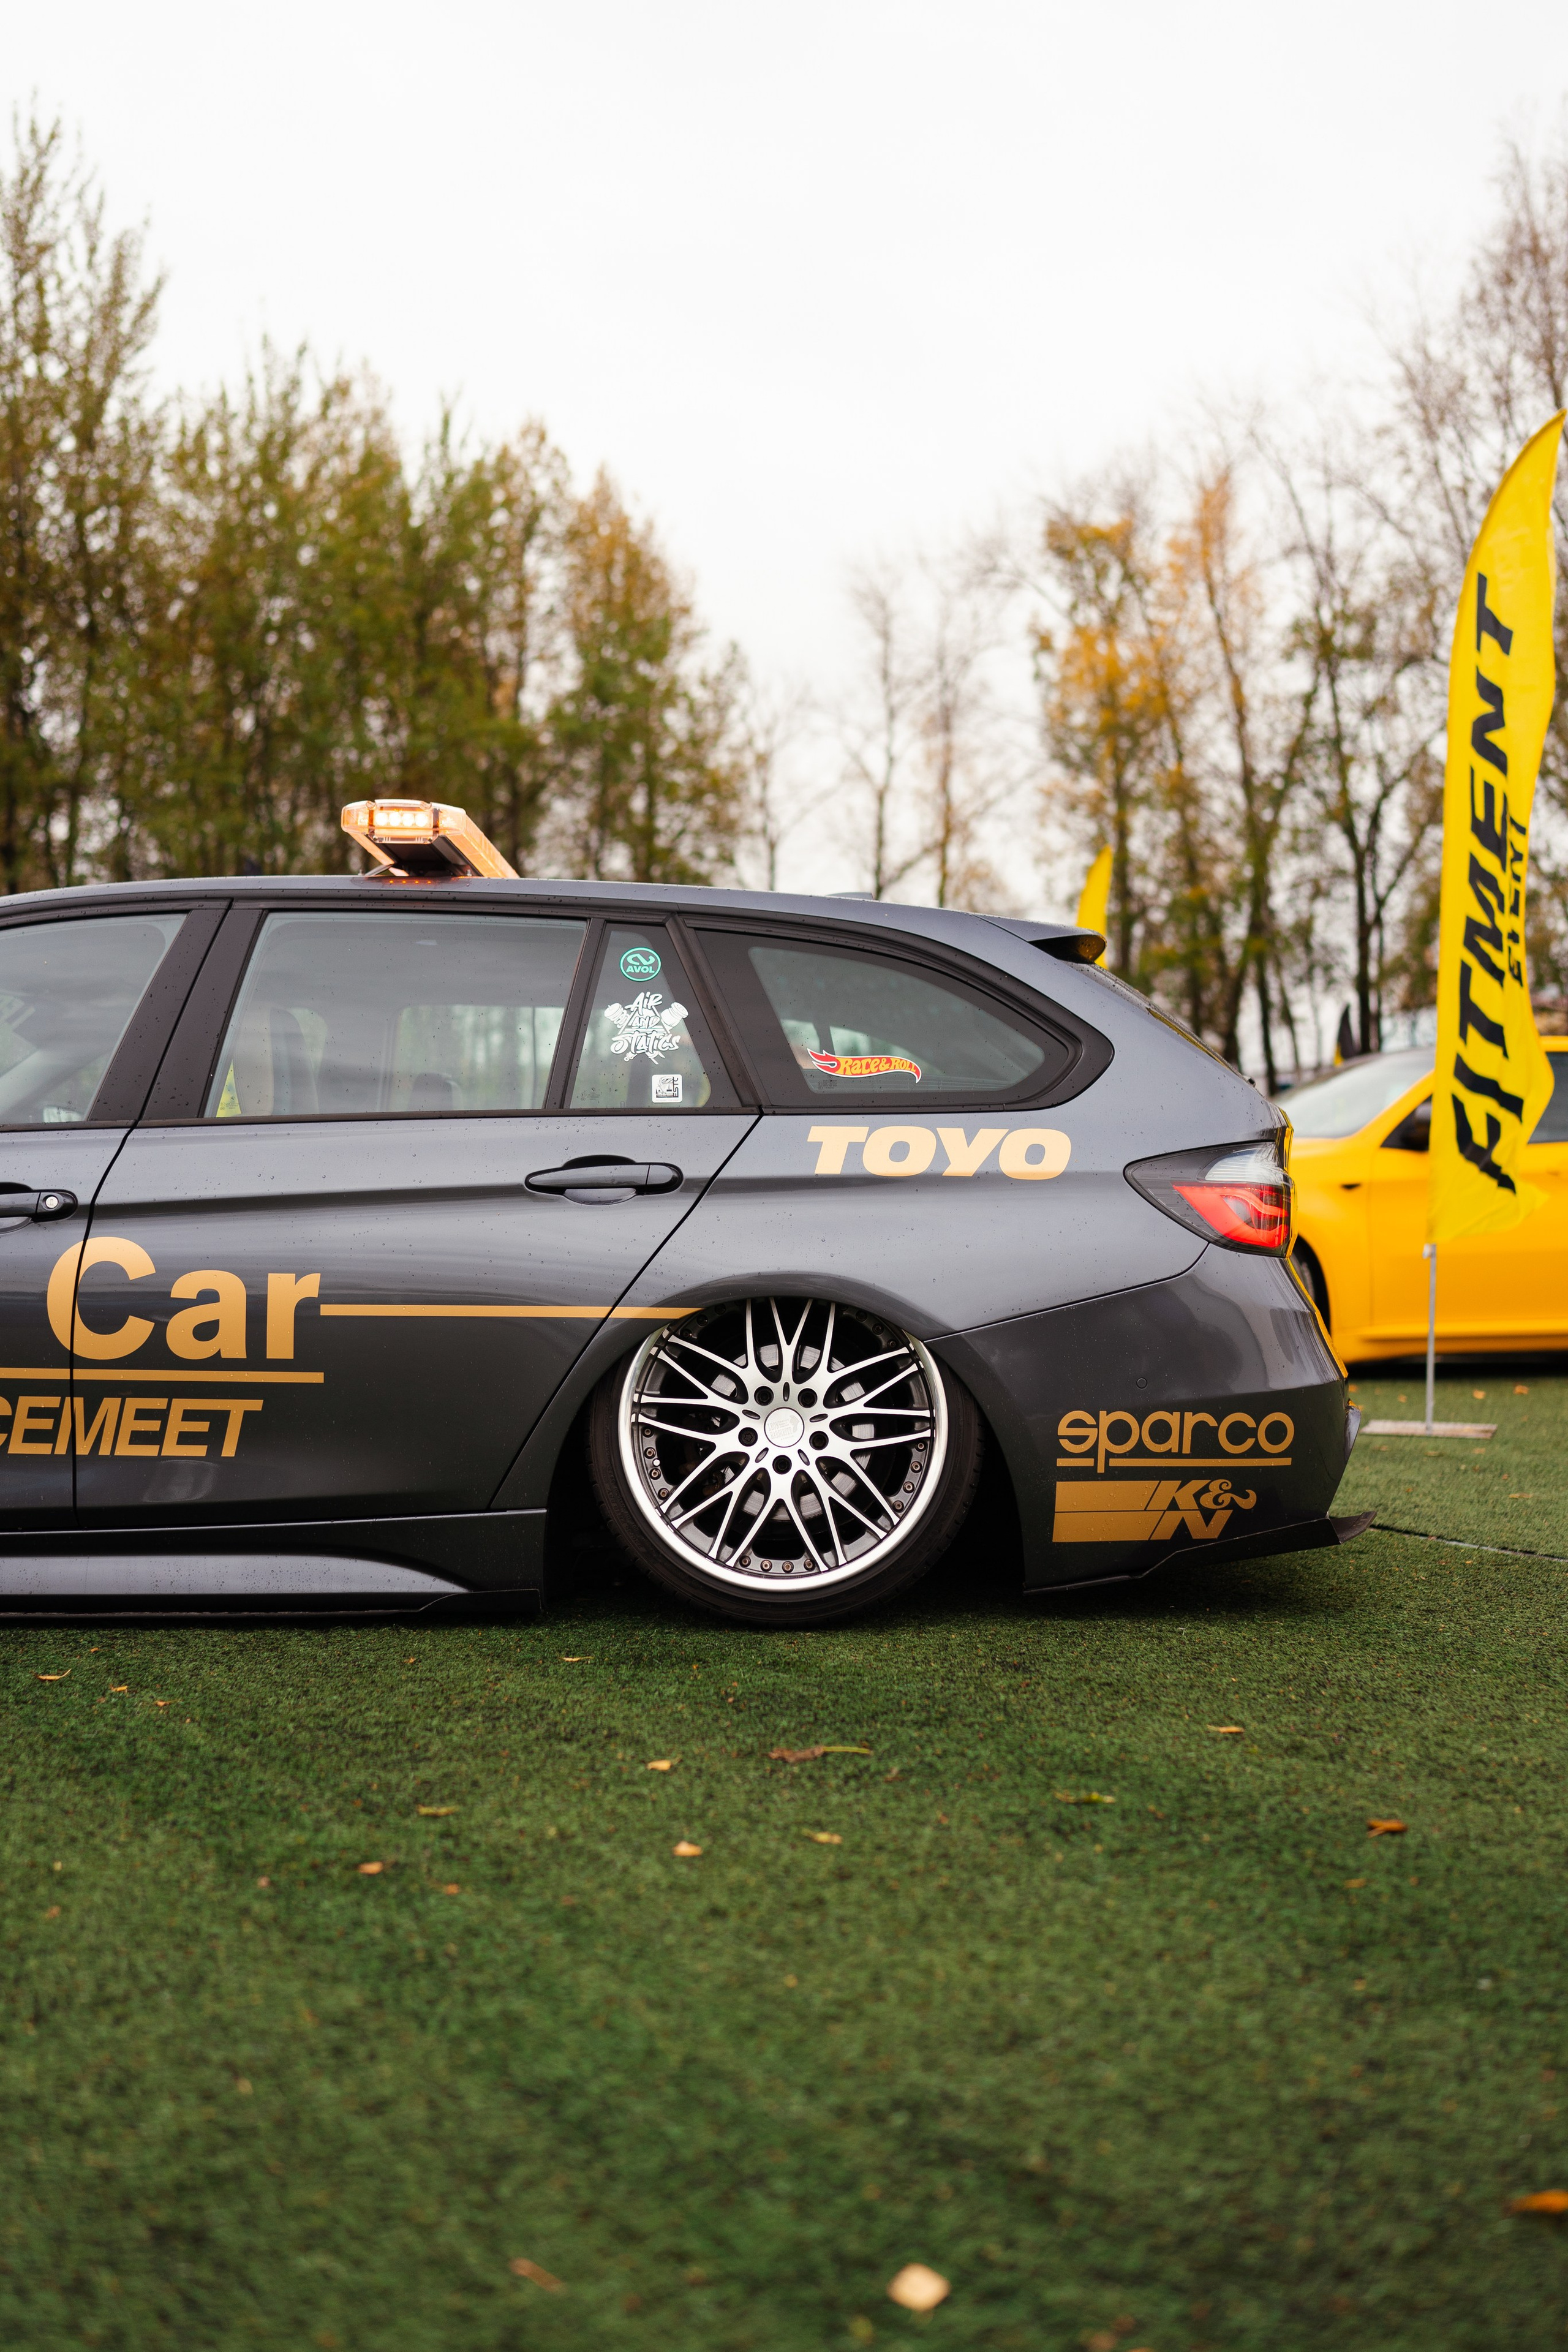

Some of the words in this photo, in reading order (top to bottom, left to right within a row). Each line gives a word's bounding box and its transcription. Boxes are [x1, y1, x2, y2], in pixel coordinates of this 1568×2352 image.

[1450, 571, 1524, 1194] FITMENT
[626, 965, 655, 973] AVOL
[628, 1016, 661, 1030] AND
[807, 1125, 1072, 1180] TOYO
[47, 1236, 321, 1360] Car
[0, 1395, 264, 1458] EMEET
[1057, 1410, 1295, 1473] sparco
